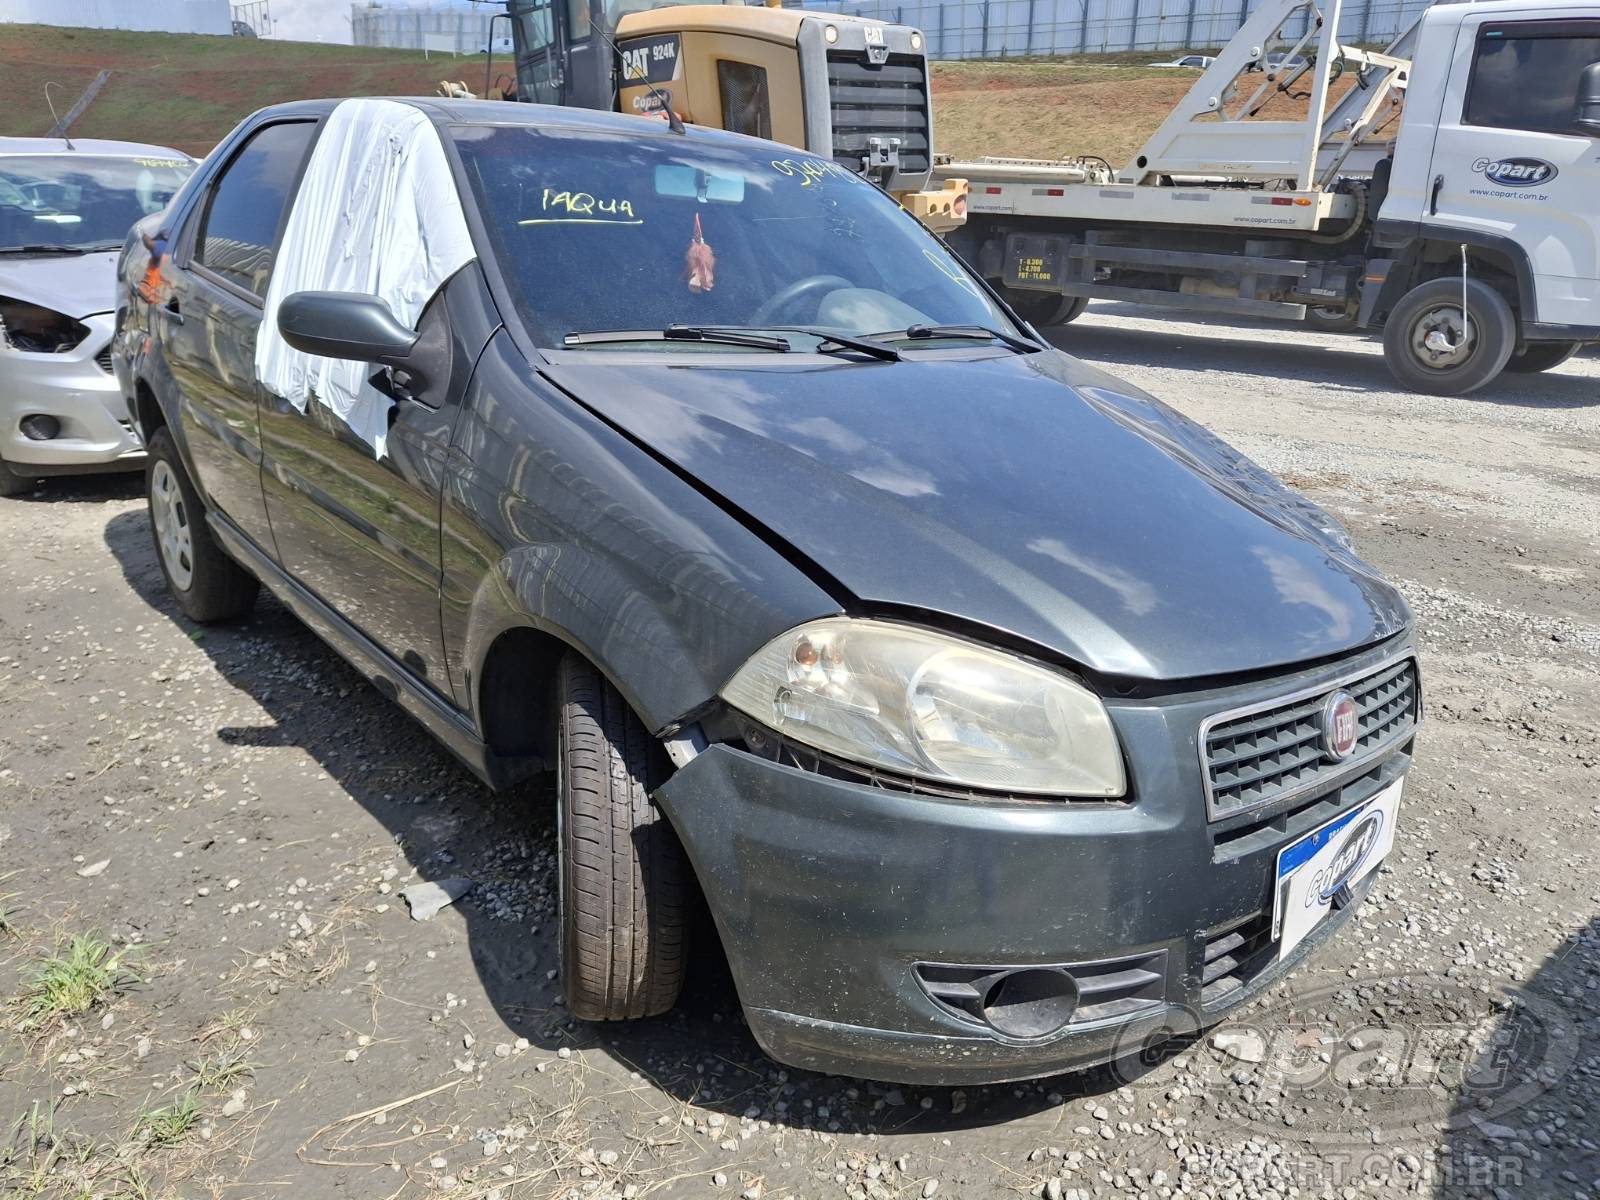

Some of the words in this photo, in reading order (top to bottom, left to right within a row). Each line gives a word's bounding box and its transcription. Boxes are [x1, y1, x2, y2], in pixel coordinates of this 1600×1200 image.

[863, 26, 884, 44] CAT
[622, 47, 649, 80] CAT
[653, 42, 676, 61] 924K
[1471, 157, 1548, 180] Copart
[1469, 188, 1549, 201] www.copart.com.br
[1233, 215, 1297, 225] www.copart.com.br
[1305, 816, 1376, 908] Copart
